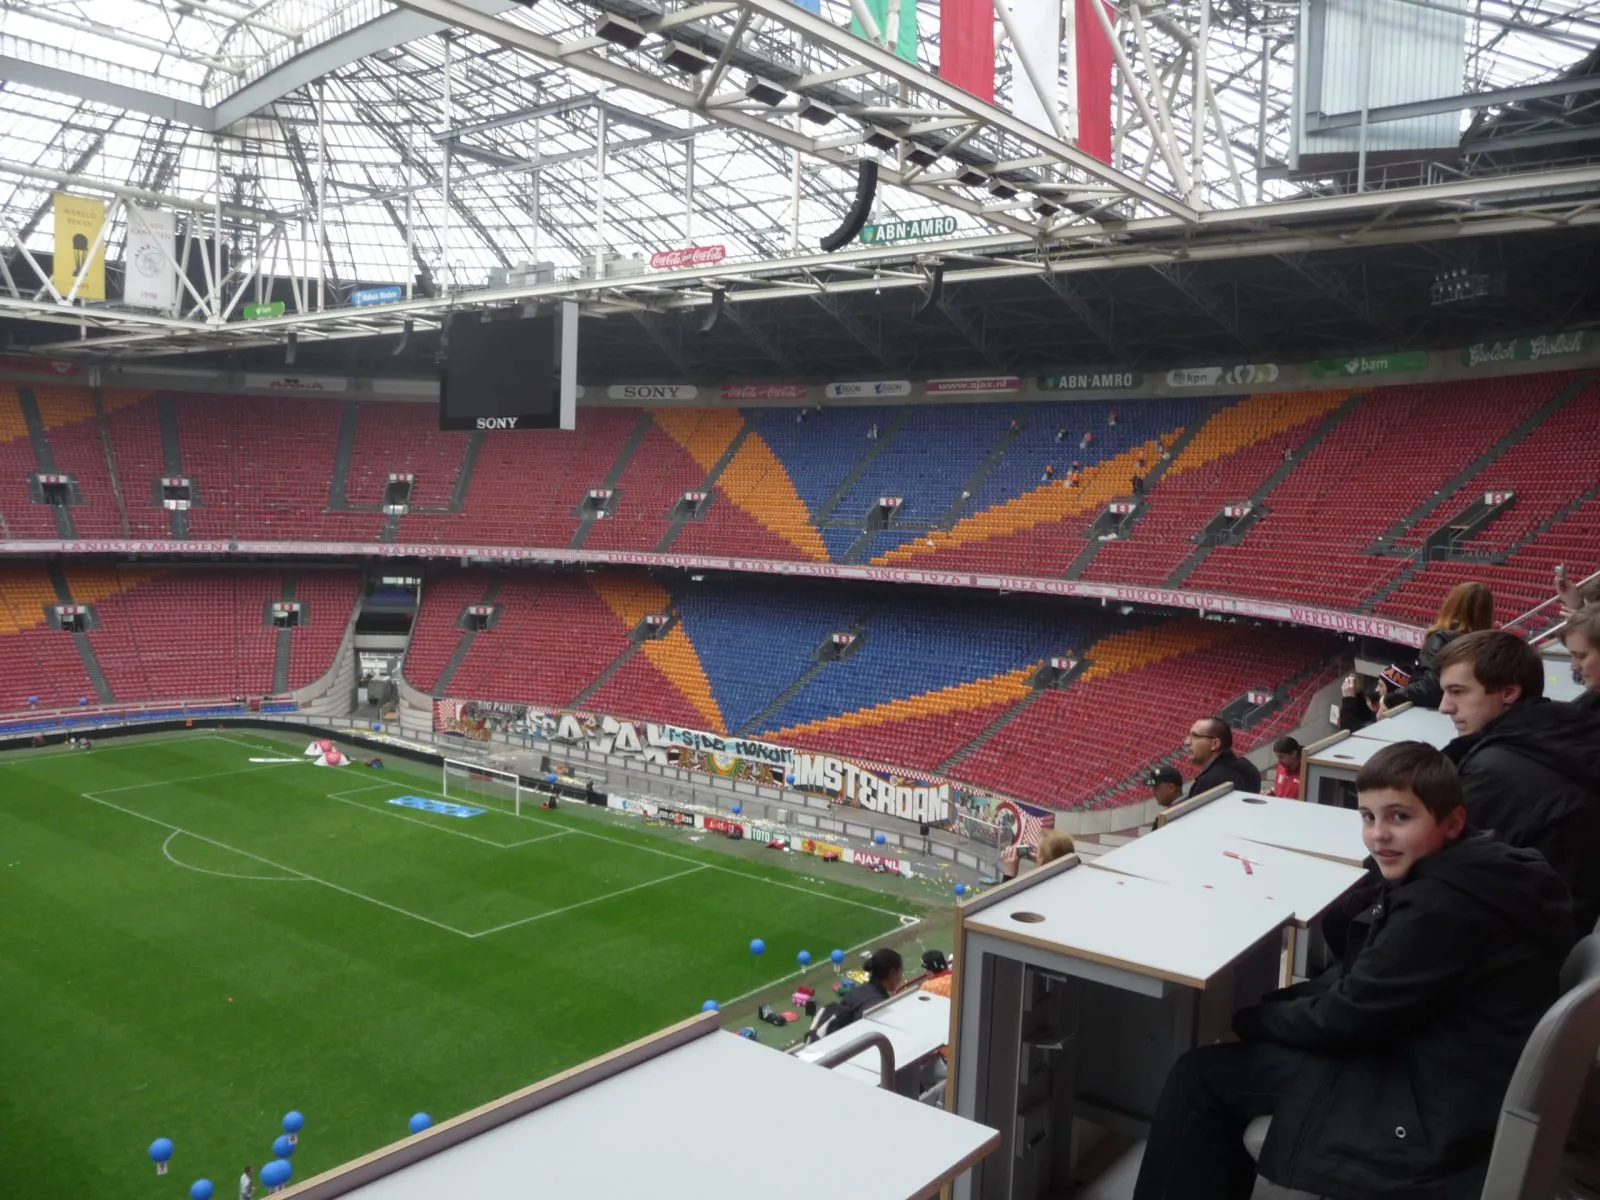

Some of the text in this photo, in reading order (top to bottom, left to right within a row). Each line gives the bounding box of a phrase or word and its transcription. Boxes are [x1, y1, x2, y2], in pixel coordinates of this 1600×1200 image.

[624, 386, 681, 398] SONY
[476, 417, 518, 429] SONY
[62, 542, 224, 553] LANDSKAMPIOEN
[608, 552, 690, 567] EUROPACUP
[742, 560, 776, 573] AJAX
[795, 565, 841, 578] F-SIDE
[866, 569, 961, 586] SINCE 1976
[1045, 580, 1076, 595] CUP
[1116, 588, 1214, 610] EUROPACUP
[751, 827, 770, 842] TOTO
